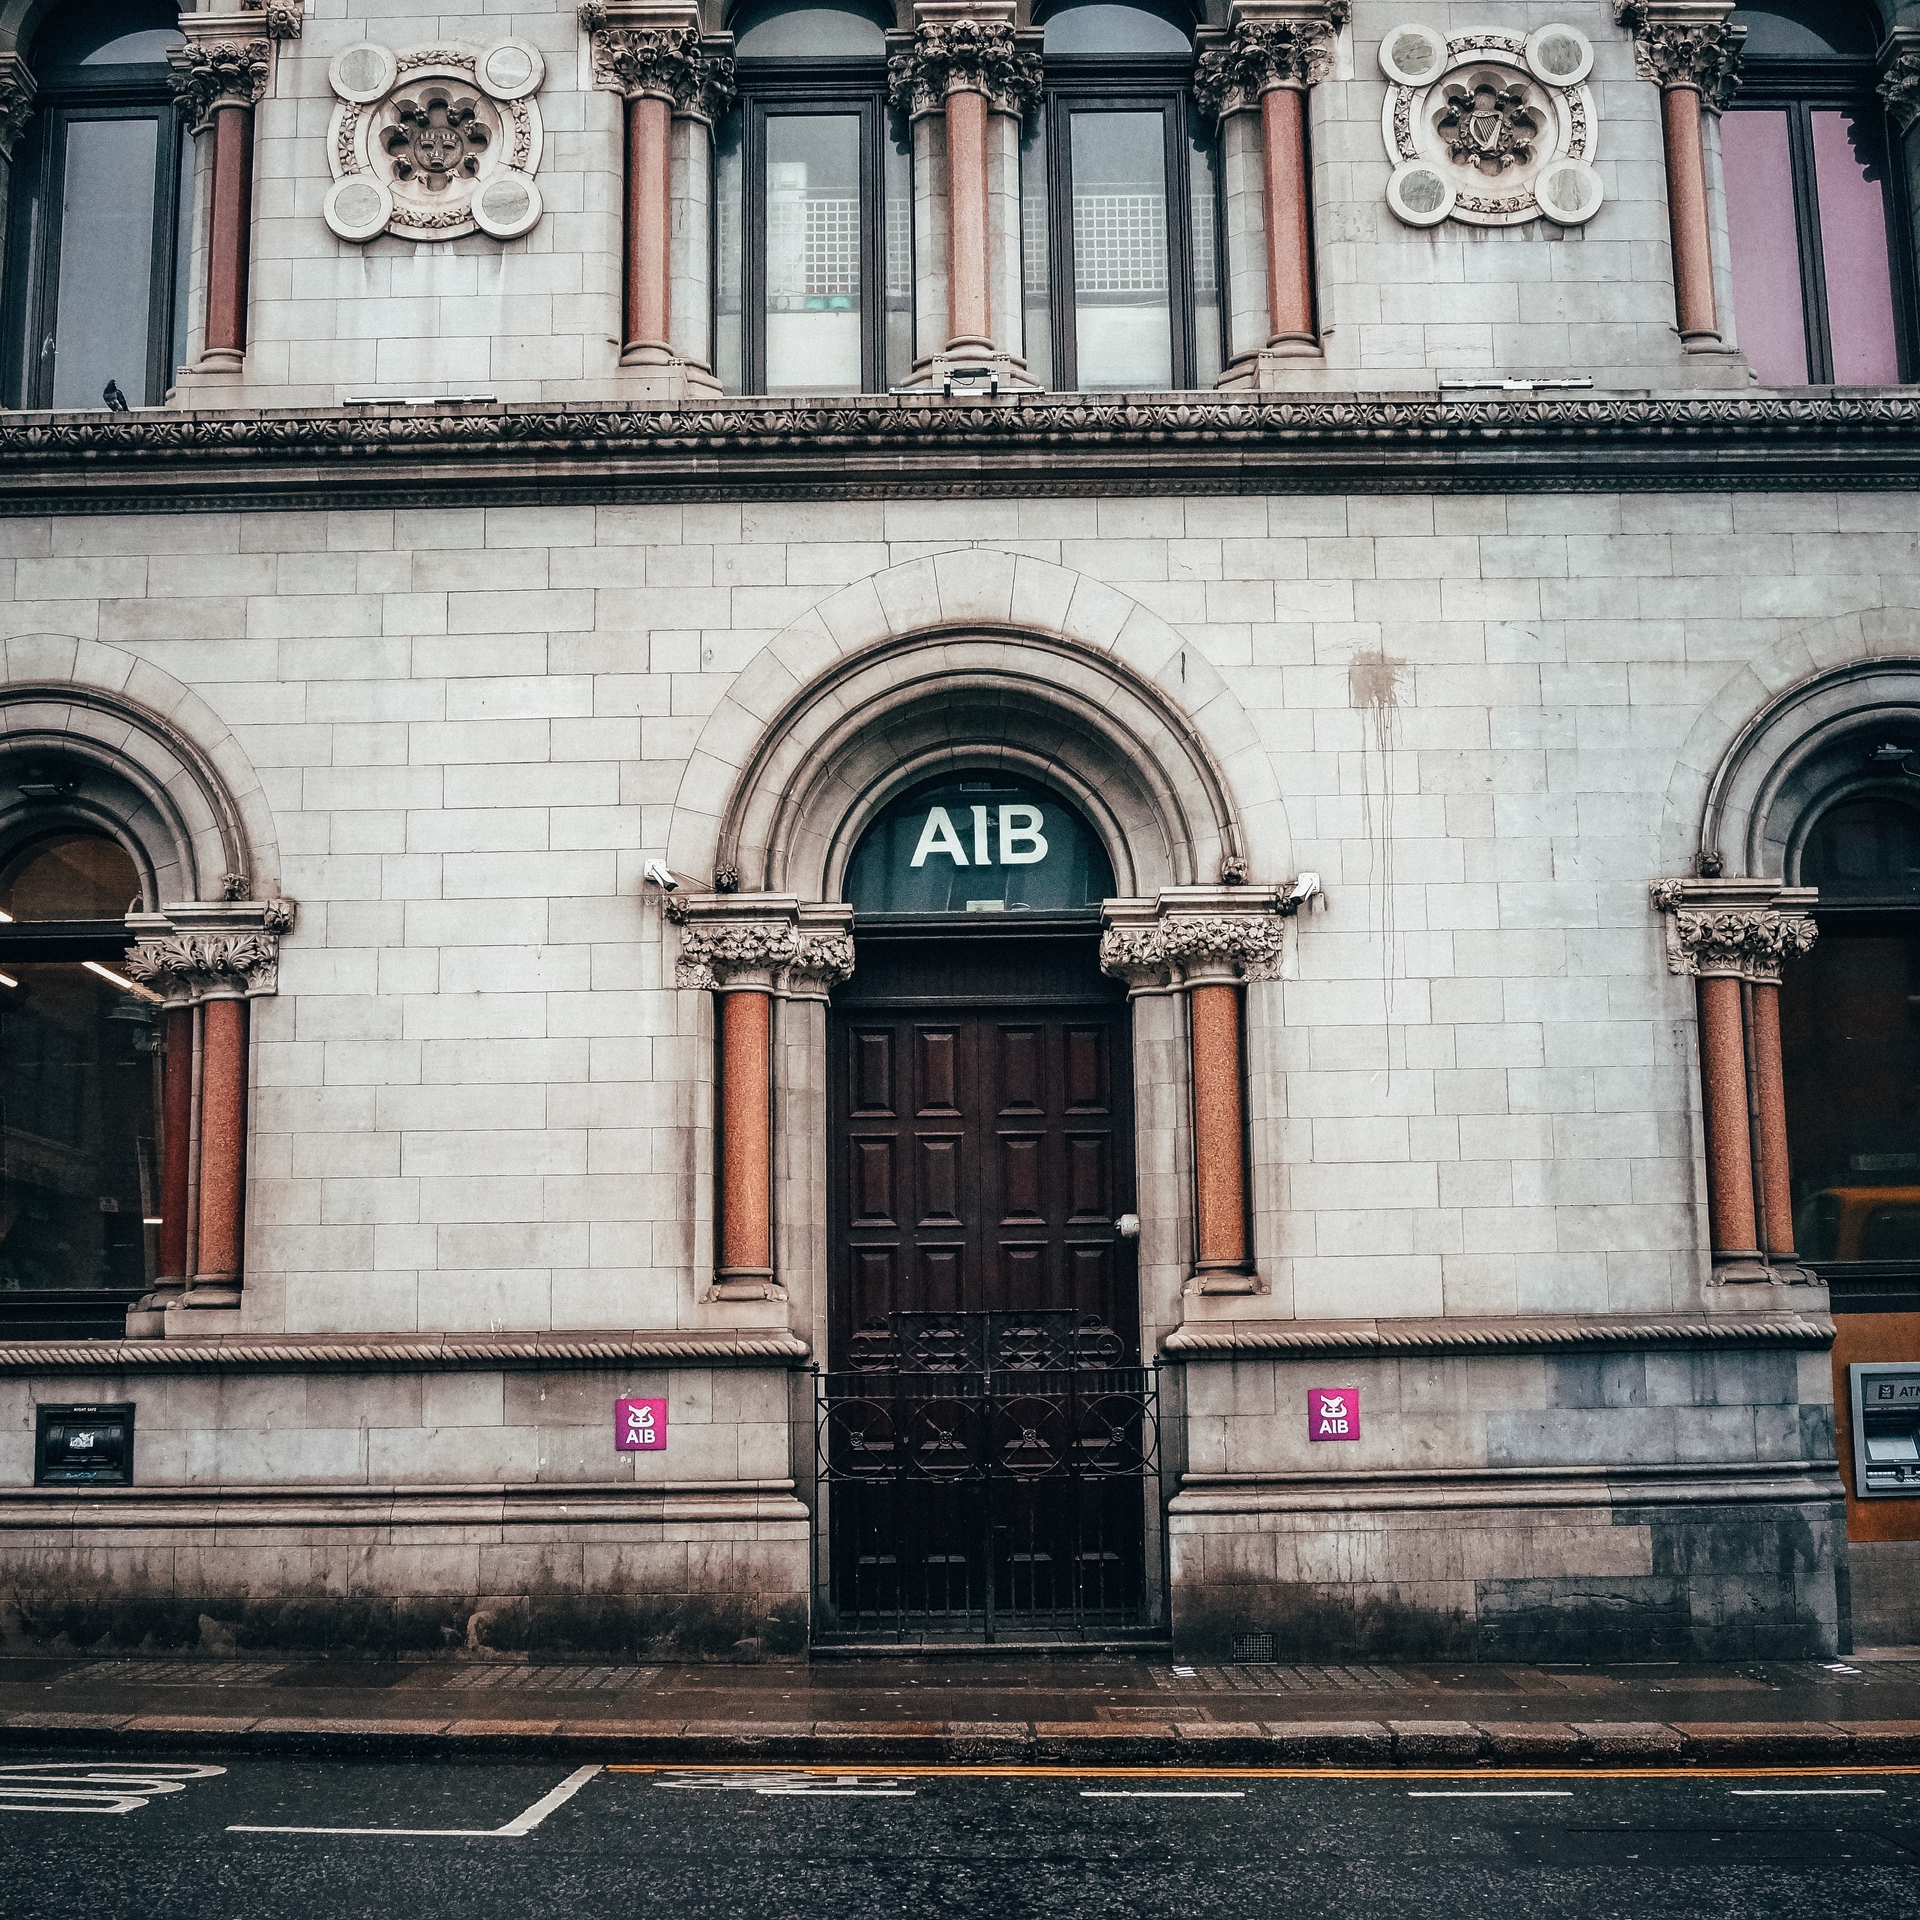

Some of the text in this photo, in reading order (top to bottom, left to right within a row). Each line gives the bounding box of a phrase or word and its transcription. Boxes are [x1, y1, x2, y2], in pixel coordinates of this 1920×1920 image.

[909, 804, 1049, 867] AIB
[1319, 1419, 1349, 1434] AIB
[625, 1429, 656, 1444] AIB
